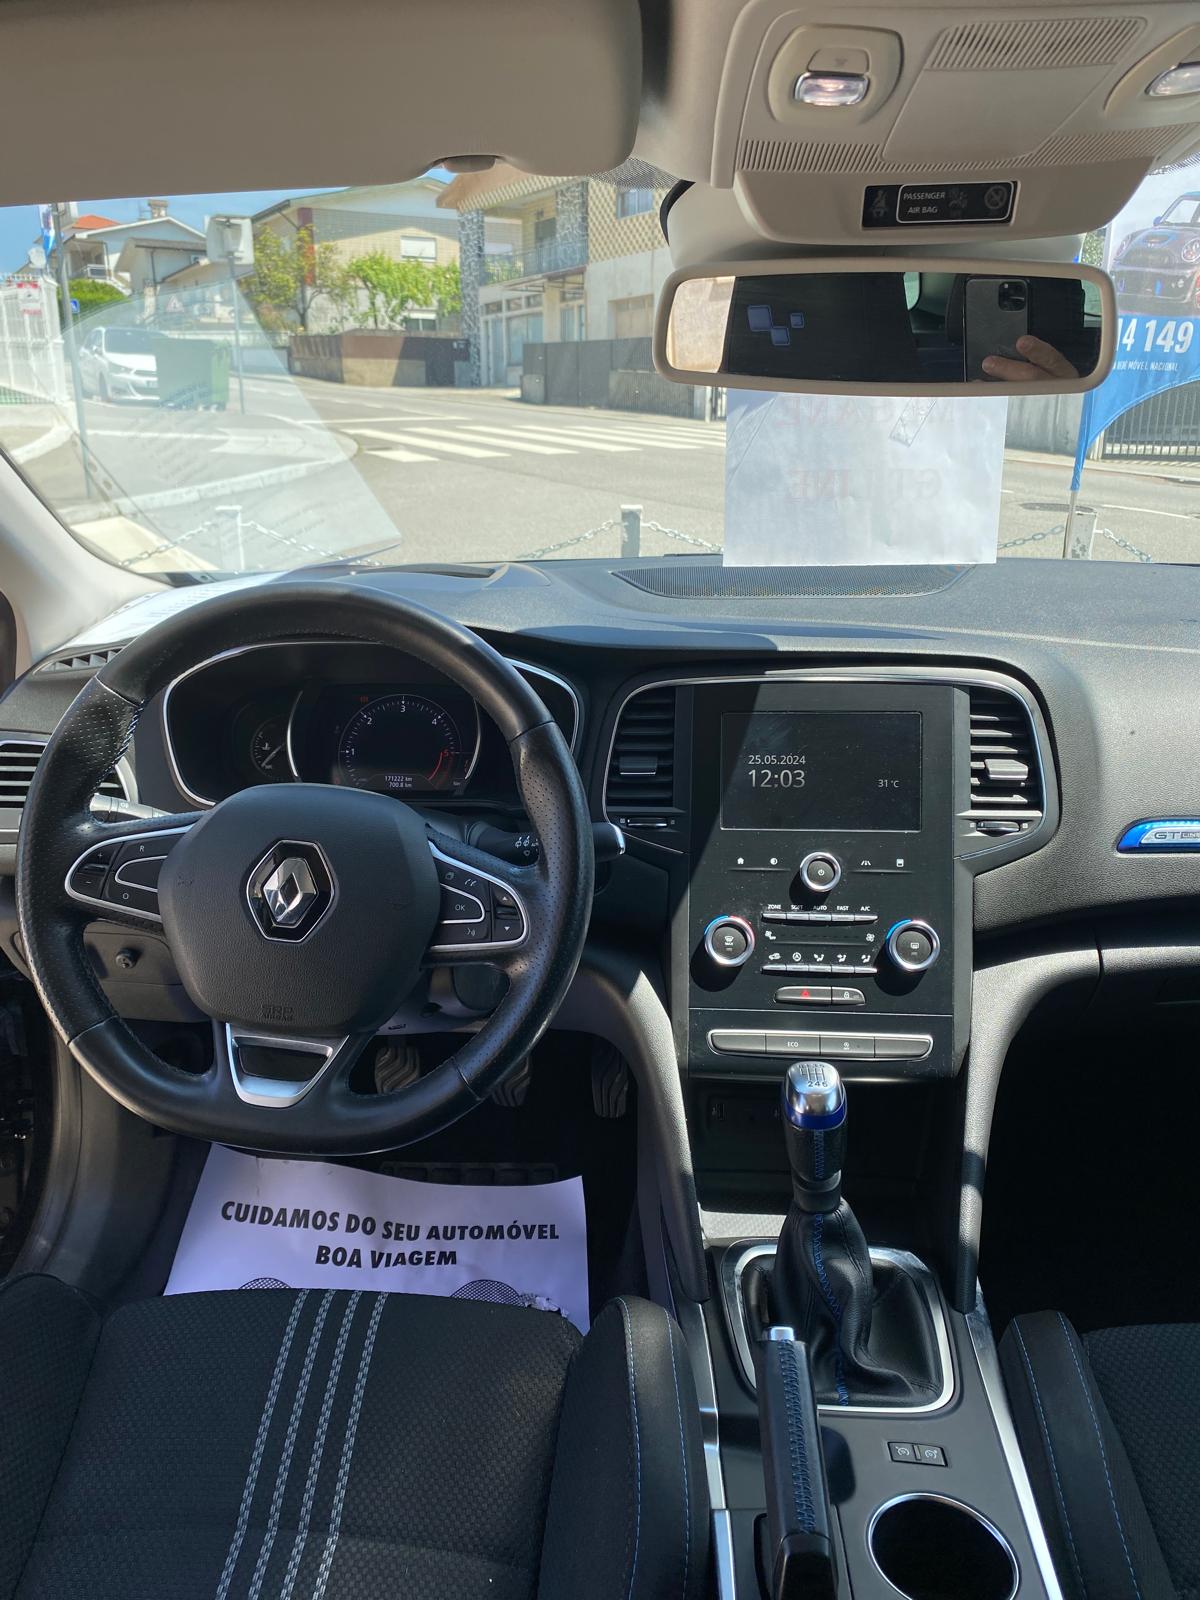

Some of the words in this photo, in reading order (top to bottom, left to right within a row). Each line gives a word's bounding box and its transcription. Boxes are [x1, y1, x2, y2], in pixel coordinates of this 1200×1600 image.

[903, 191, 946, 200] PASSENGER
[907, 206, 920, 214] AIR
[1143, 319, 1194, 353] 149
[1150, 361, 1179, 372] NACIONAL
[400, 705, 406, 713] 3
[367, 717, 372, 725] 2
[748, 754, 806, 765] 25.05.2024
[748, 769, 805, 788] 12:03
[877, 779, 888, 788] 31
[1154, 831, 1180, 840] GT
[454, 904, 466, 912] OK
[221, 1201, 340, 1232] CUIDAMOS
[345, 1213, 377, 1236] DO
[382, 1220, 420, 1241] SEU
[426, 1220, 560, 1241] AUTOMÓVEL
[315, 1245, 362, 1268] BOA
[370, 1250, 457, 1269] VIAGEM
